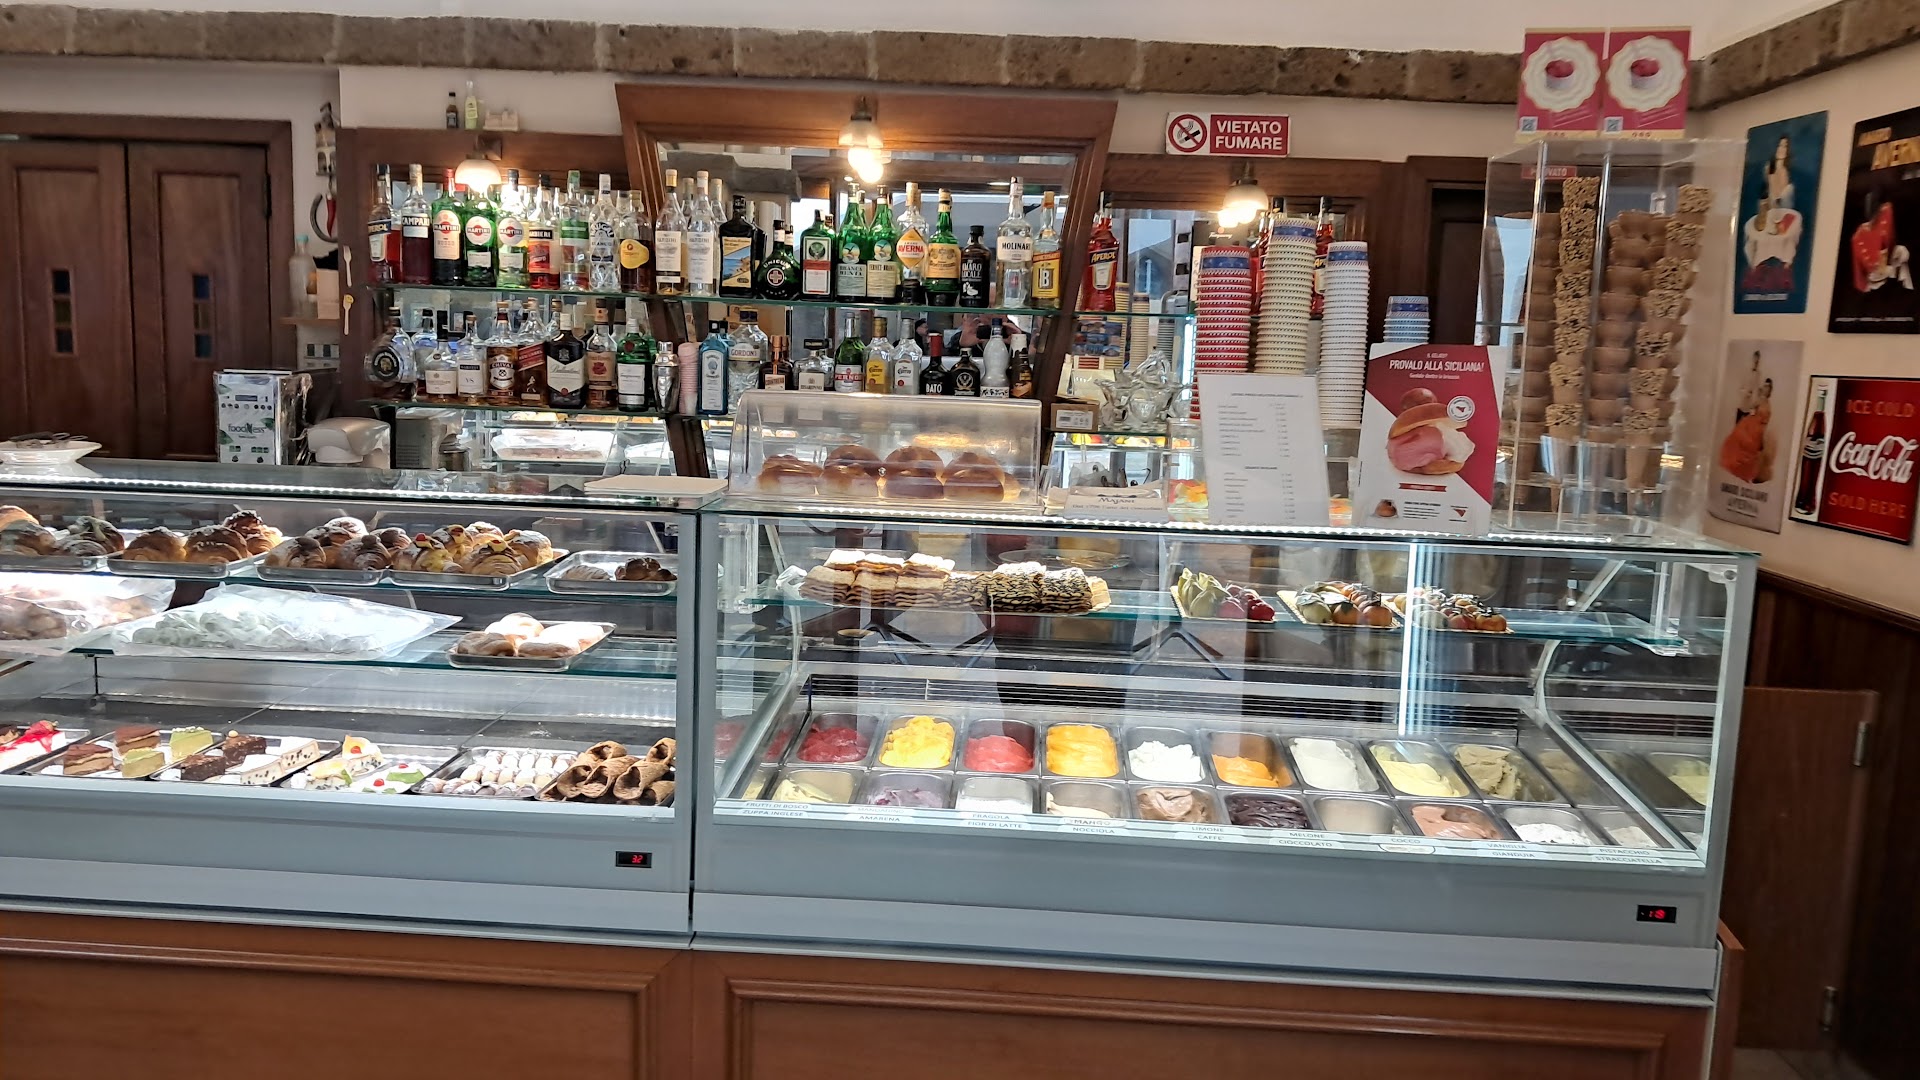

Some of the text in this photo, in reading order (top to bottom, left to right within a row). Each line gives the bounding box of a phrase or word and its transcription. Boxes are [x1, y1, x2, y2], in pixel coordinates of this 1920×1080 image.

[1216, 120, 1282, 134] VIETATO
[1215, 136, 1282, 150] FUMARE
[898, 244, 924, 253] AVERNA
[1091, 251, 1115, 262] APEROL
[763, 259, 791, 269] UNICUM
[1389, 360, 1485, 372] PROVALO ALLA SICILIANA!
[925, 383, 942, 393] BATO
[1846, 399, 1914, 417] ICE COLD
[1828, 491, 1907, 519] SOLD HERE
[1073, 818, 1111, 826] MANGO
[1072, 826, 1116, 834] NOCCIOLA
[1289, 831, 1325, 839] MELONE
[1278, 839, 1333, 847] CIOCCOLATO
[1486, 842, 1527, 850] VANIGLIA
[1599, 848, 1651, 856] PISTACCHIO
[631, 854, 644, 864] 32
[1595, 855, 1663, 864] STRACCIATELLA
